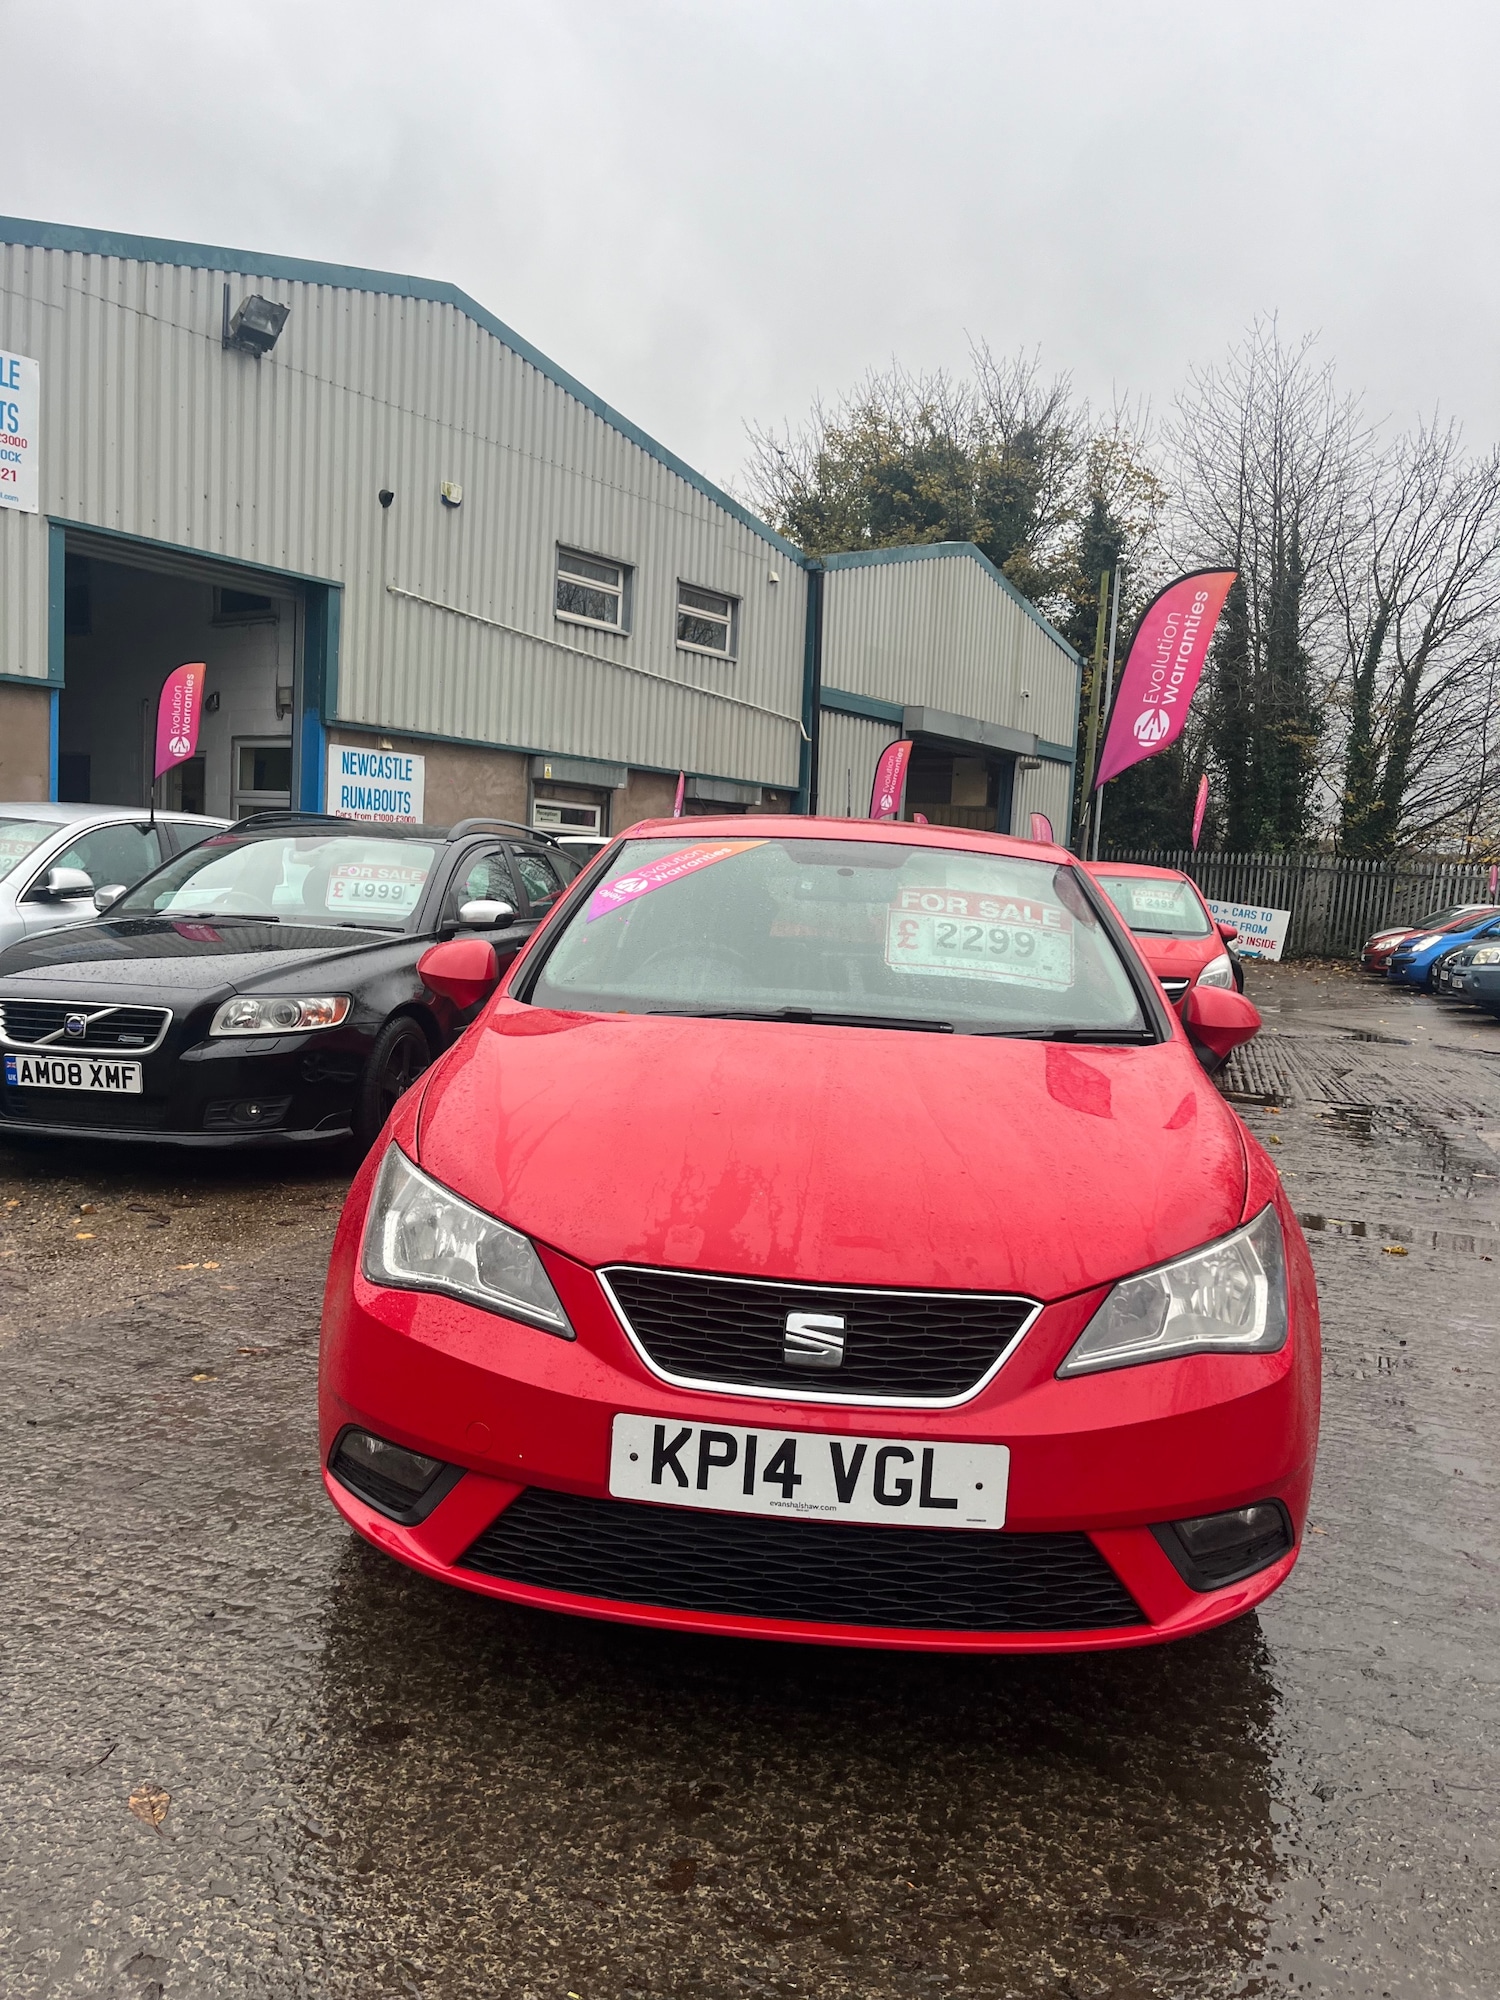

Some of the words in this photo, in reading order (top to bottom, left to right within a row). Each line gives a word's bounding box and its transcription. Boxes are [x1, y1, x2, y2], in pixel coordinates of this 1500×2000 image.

[0, 433, 28, 449] 3000
[1143, 612, 1181, 704] Evolution
[1162, 591, 1209, 705] Warranties
[170, 685, 182, 734] Evolution
[182, 673, 195, 735] Warranties
[342, 751, 412, 781] NEWCASTLE
[882, 755, 894, 793] Evolution
[889, 747, 904, 794] Warranties
[341, 785, 411, 814] RUNABOUTS
[355, 811, 372, 821] from
[337, 865, 373, 877] FOR
[377, 868, 422, 881] SALE
[639, 848, 705, 878] Evolution
[650, 847, 732, 882] Warranties
[333, 881, 345, 898] £
[352, 882, 403, 900] 1999
[901, 891, 968, 914] FOR
[979, 900, 1062, 928] SALE
[1232, 907, 1257, 920] CARS
[1261, 911, 1273, 922] TO
[897, 919, 919, 950] £
[936, 922, 1036, 958] 2299
[1240, 922, 1268, 935] FROM
[1246, 936, 1277, 950] INSIDE
[21, 1060, 82, 1085] AM08
[90, 1064, 135, 1089] XMF
[650, 1424, 802, 1499] KP14
[829, 1441, 958, 1510] VGL
[769, 1500, 837, 1513] evanshalshaw.com
